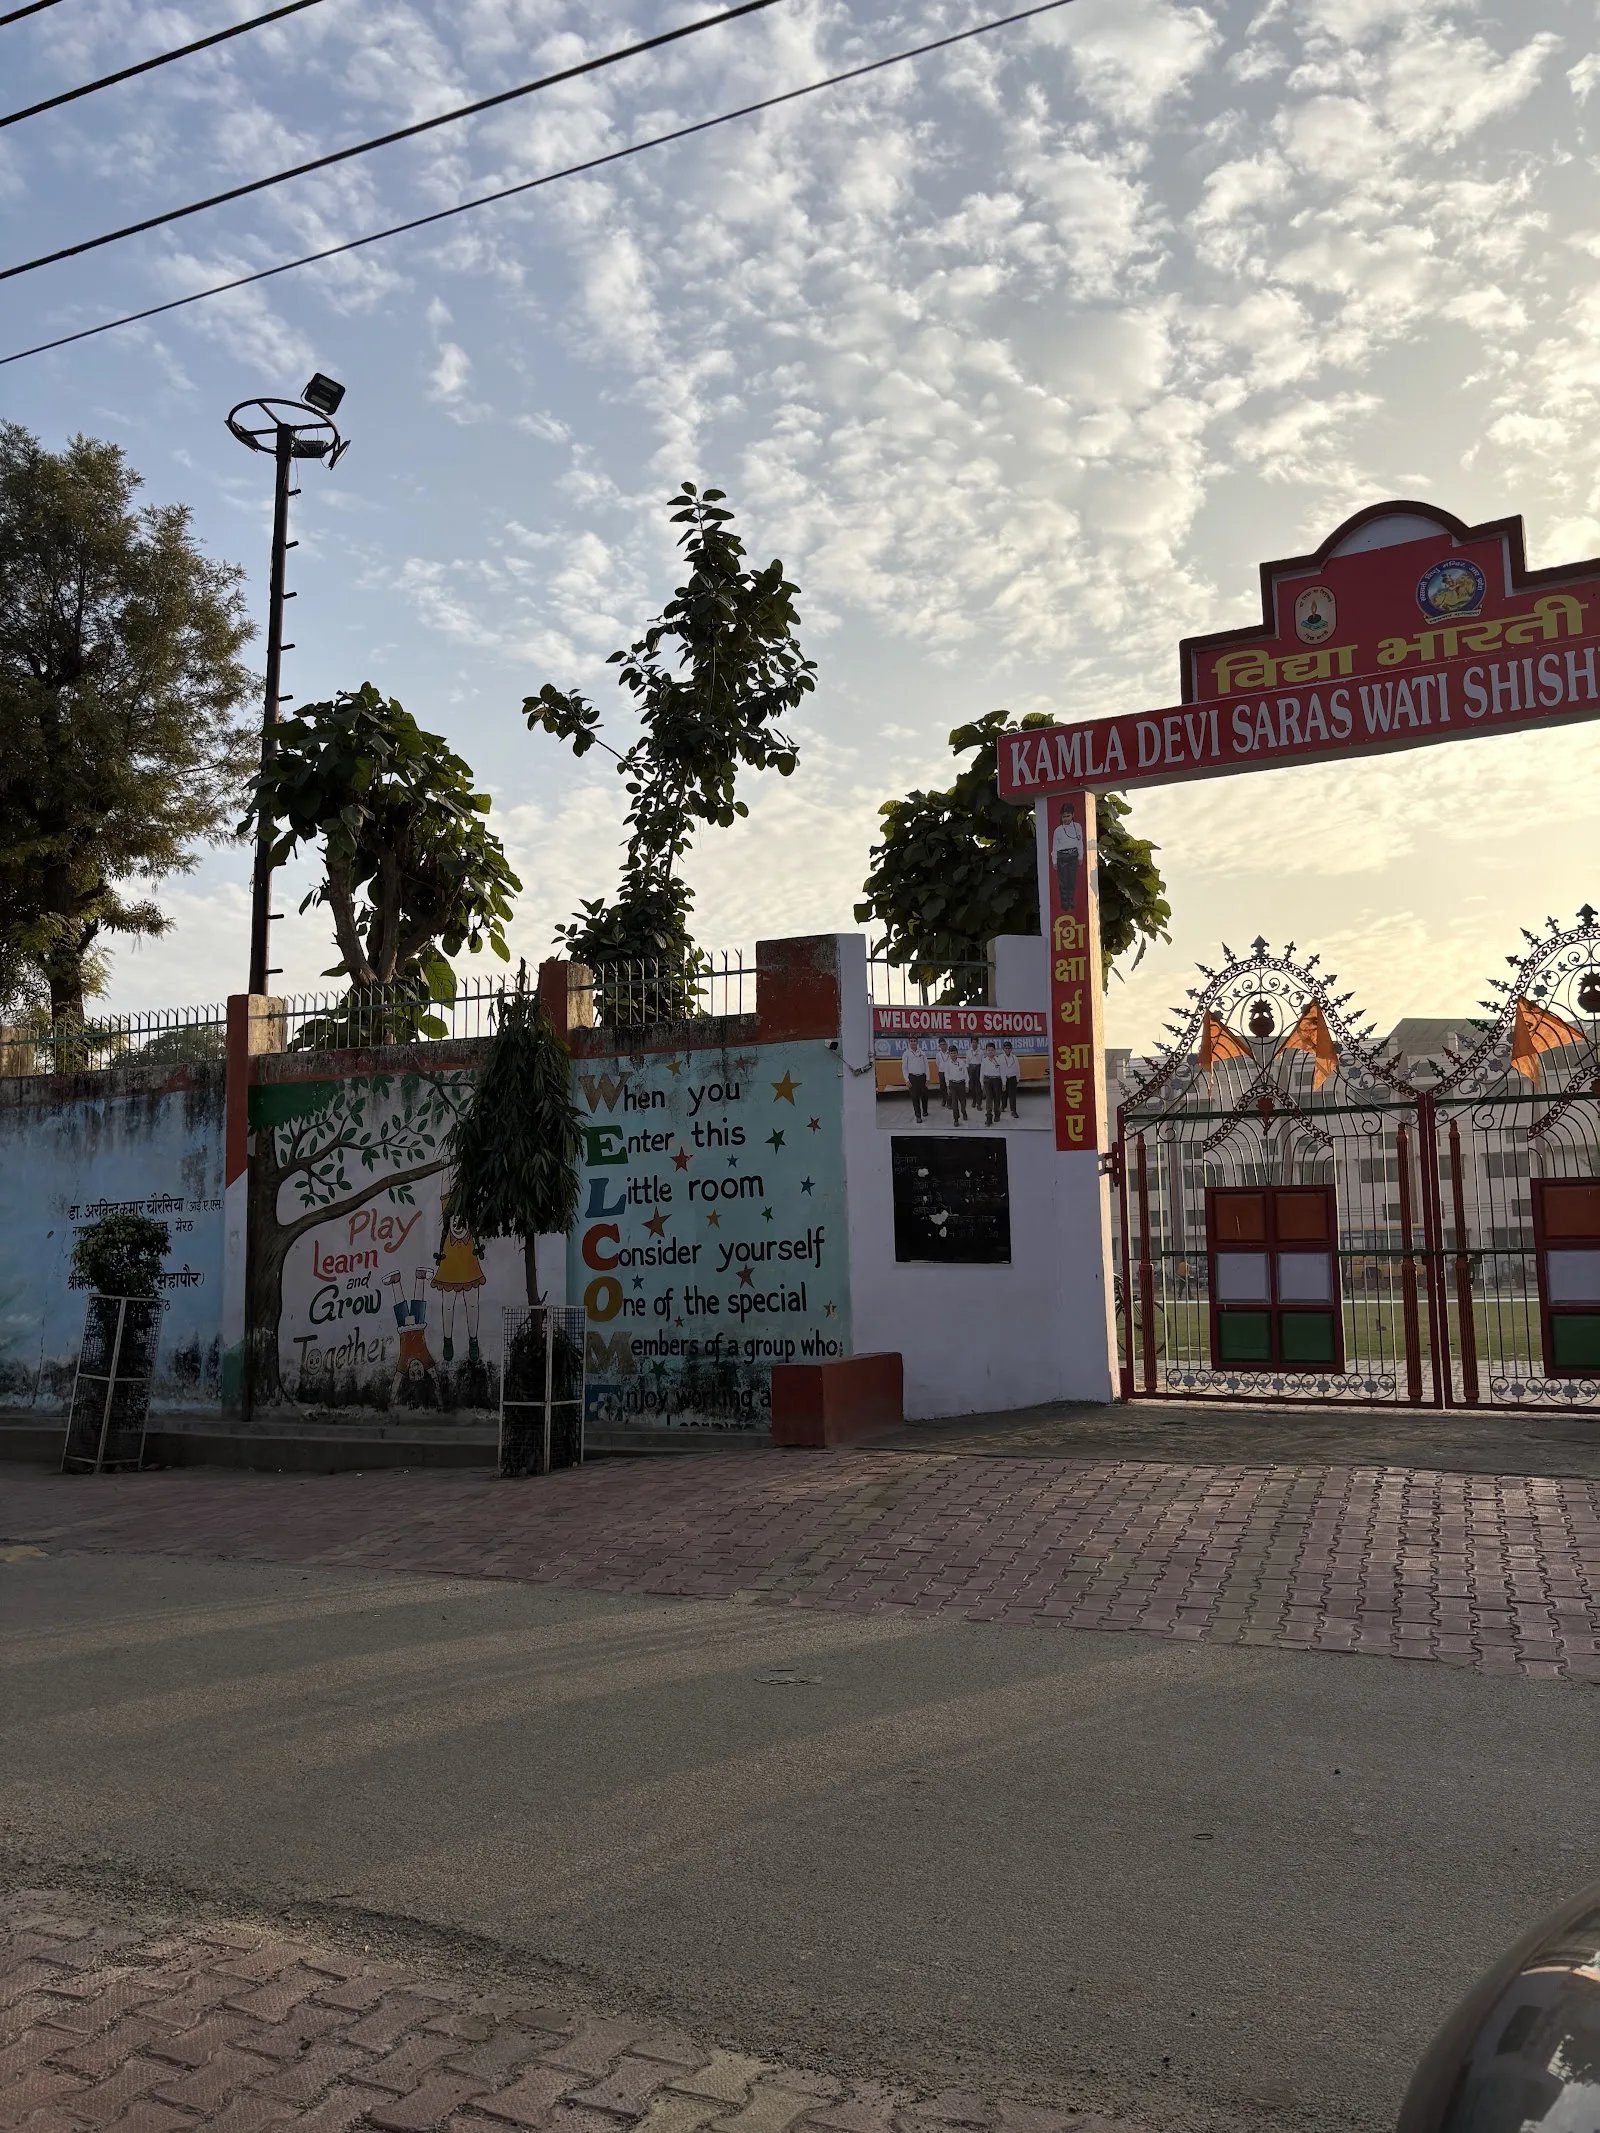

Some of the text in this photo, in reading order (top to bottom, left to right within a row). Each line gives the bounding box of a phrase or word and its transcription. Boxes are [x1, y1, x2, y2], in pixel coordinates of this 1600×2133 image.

[1211, 594, 1588, 695] विद्या भारती
[1010, 725, 1127, 787] KAMLA
[1136, 709, 1221, 768] DEVI
[1463, 645, 1600, 719] SHISH
[878, 1010, 1043, 1032] WELCOME TO SCHOOL
[578, 1071, 741, 1117] When you
[582, 1117, 746, 1167] Enter this
[584, 1174, 764, 1218] Little room
[348, 1208, 423, 1253] Play
[582, 1223, 825, 1272] Consider yourself
[313, 1240, 380, 1282] Learn
[346, 1271, 372, 1289] and
[309, 1285, 381, 1325] Grow
[583, 1276, 807, 1323] One of the special
[584, 1329, 698, 1374] Members
[704, 1333, 725, 1362] of
[728, 1341, 740, 1356] a
[743, 1337, 795, 1365] group
